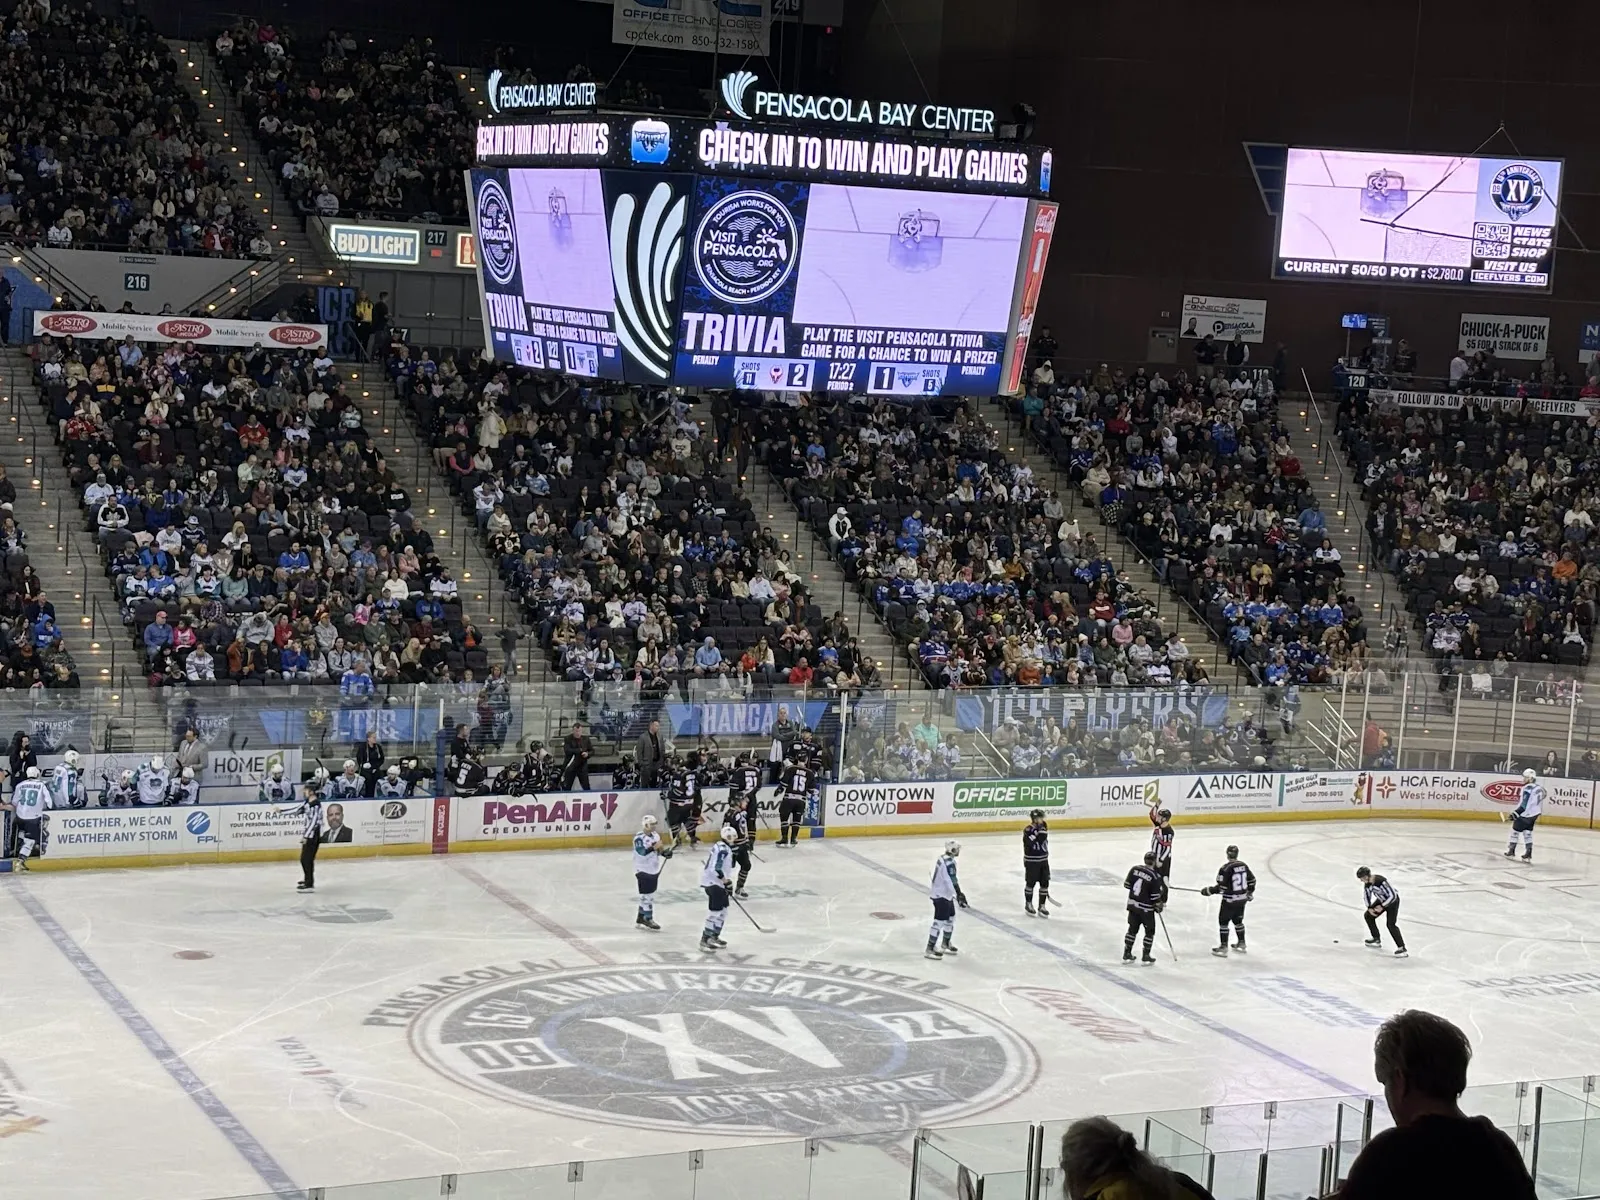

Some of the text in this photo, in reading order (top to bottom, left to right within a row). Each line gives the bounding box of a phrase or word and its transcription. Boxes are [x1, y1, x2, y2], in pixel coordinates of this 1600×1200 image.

[626, 29, 759, 50] cpctek.com 850-432-1580
[500, 82, 597, 108] PENSACOLA BAY CENTER
[755, 91, 994, 133] PENSACOLA BAY CENTER
[532, 124, 549, 154] AND
[550, 123, 571, 154] PLAY
[571, 122, 609, 155] GAMES
[699, 129, 1028, 184] CHECK IN TO WIN AND PLAY GAMES
[1507, 179, 1529, 202] XV
[713, 199, 787, 228] TOURISM WORKS FOR YOU
[428, 231, 445, 244] 217
[709, 229, 738, 243] VISIT
[1513, 226, 1551, 237] NEWS
[337, 233, 413, 256] BUD LIGHT
[703, 240, 778, 259] PENSACOLA
[1513, 236, 1552, 248] STATS
[1511, 247, 1548, 258] SHOP
[1283, 260, 1348, 275] CURRENT
[1351, 264, 1387, 277] 50/50
[1390, 267, 1419, 278] POT
[1483, 260, 1538, 272] VISIT US
[127, 275, 147, 289] 216
[705, 263, 782, 294] PENSACOLA BEACH PERDIDO KEY
[485, 292, 529, 331] TRIVIA
[54, 316, 314, 341] ASTRO Mobile Service ASTRO Mobile Service ASTRO
[682, 312, 786, 354] TRIVIA
[1461, 321, 1546, 340] CHUCK-A-PUCK
[802, 327, 983, 348] PLAY THE VISIT PENSACOLA TRIVIA
[533, 341, 541, 363] 2
[801, 343, 997, 365] GAME FOR A CHANCE TO WIN A PRIZE!
[1466, 340, 1476, 349] $5
[1477, 340, 1492, 350] FOR
[1498, 341, 1521, 352] STACK
[1522, 343, 1532, 352] OF
[692, 355, 720, 366] PENALTY
[741, 362, 760, 371] SHOTS
[745, 373, 753, 383] 11
[792, 364, 805, 386] 2
[829, 362, 857, 380] 17:27
[882, 367, 891, 389] 1
[922, 369, 941, 378] SHOTS
[961, 366, 986, 376] PENALTY
[827, 381, 854, 391] PERIOD 2
[1348, 375, 1365, 388] 120
[1397, 392, 1460, 407] FOLLOW US ON
[703, 703, 789, 733] HANGA
[214, 757, 265, 773] HOME
[457, 769, 469, 785] 5
[793, 775, 807, 791] 15
[1209, 774, 1273, 789] ANGLIN
[1401, 776, 1476, 789] HCA Florida
[836, 787, 935, 802] DOWNTOWN
[954, 785, 1065, 803] OFFICE PRIDE
[1100, 784, 1143, 800] HOME
[1400, 791, 1469, 803] West Hospital
[1553, 787, 1589, 799] Mobile
[835, 801, 896, 816] CROWD
[1549, 797, 1590, 808] Service
[237, 811, 263, 821] TROY
[483, 799, 597, 825] PenAir
[952, 808, 998, 818] Commercial
[62, 815, 172, 829] TOGETHER WE CAN
[483, 824, 592, 835] CREDIT UNION
[57, 830, 178, 844] WEATHER ANY STORM
[197, 835, 219, 843] FPL
[1133, 878, 1143, 896] 4
[362, 950, 951, 1027] PENSACOLA BAY CENTER
[519, 972, 884, 1007] ANNIVERSARY
[459, 1041, 557, 1069] 09
[580, 1005, 845, 1081] XV
[880, 1013, 973, 1038] 24
